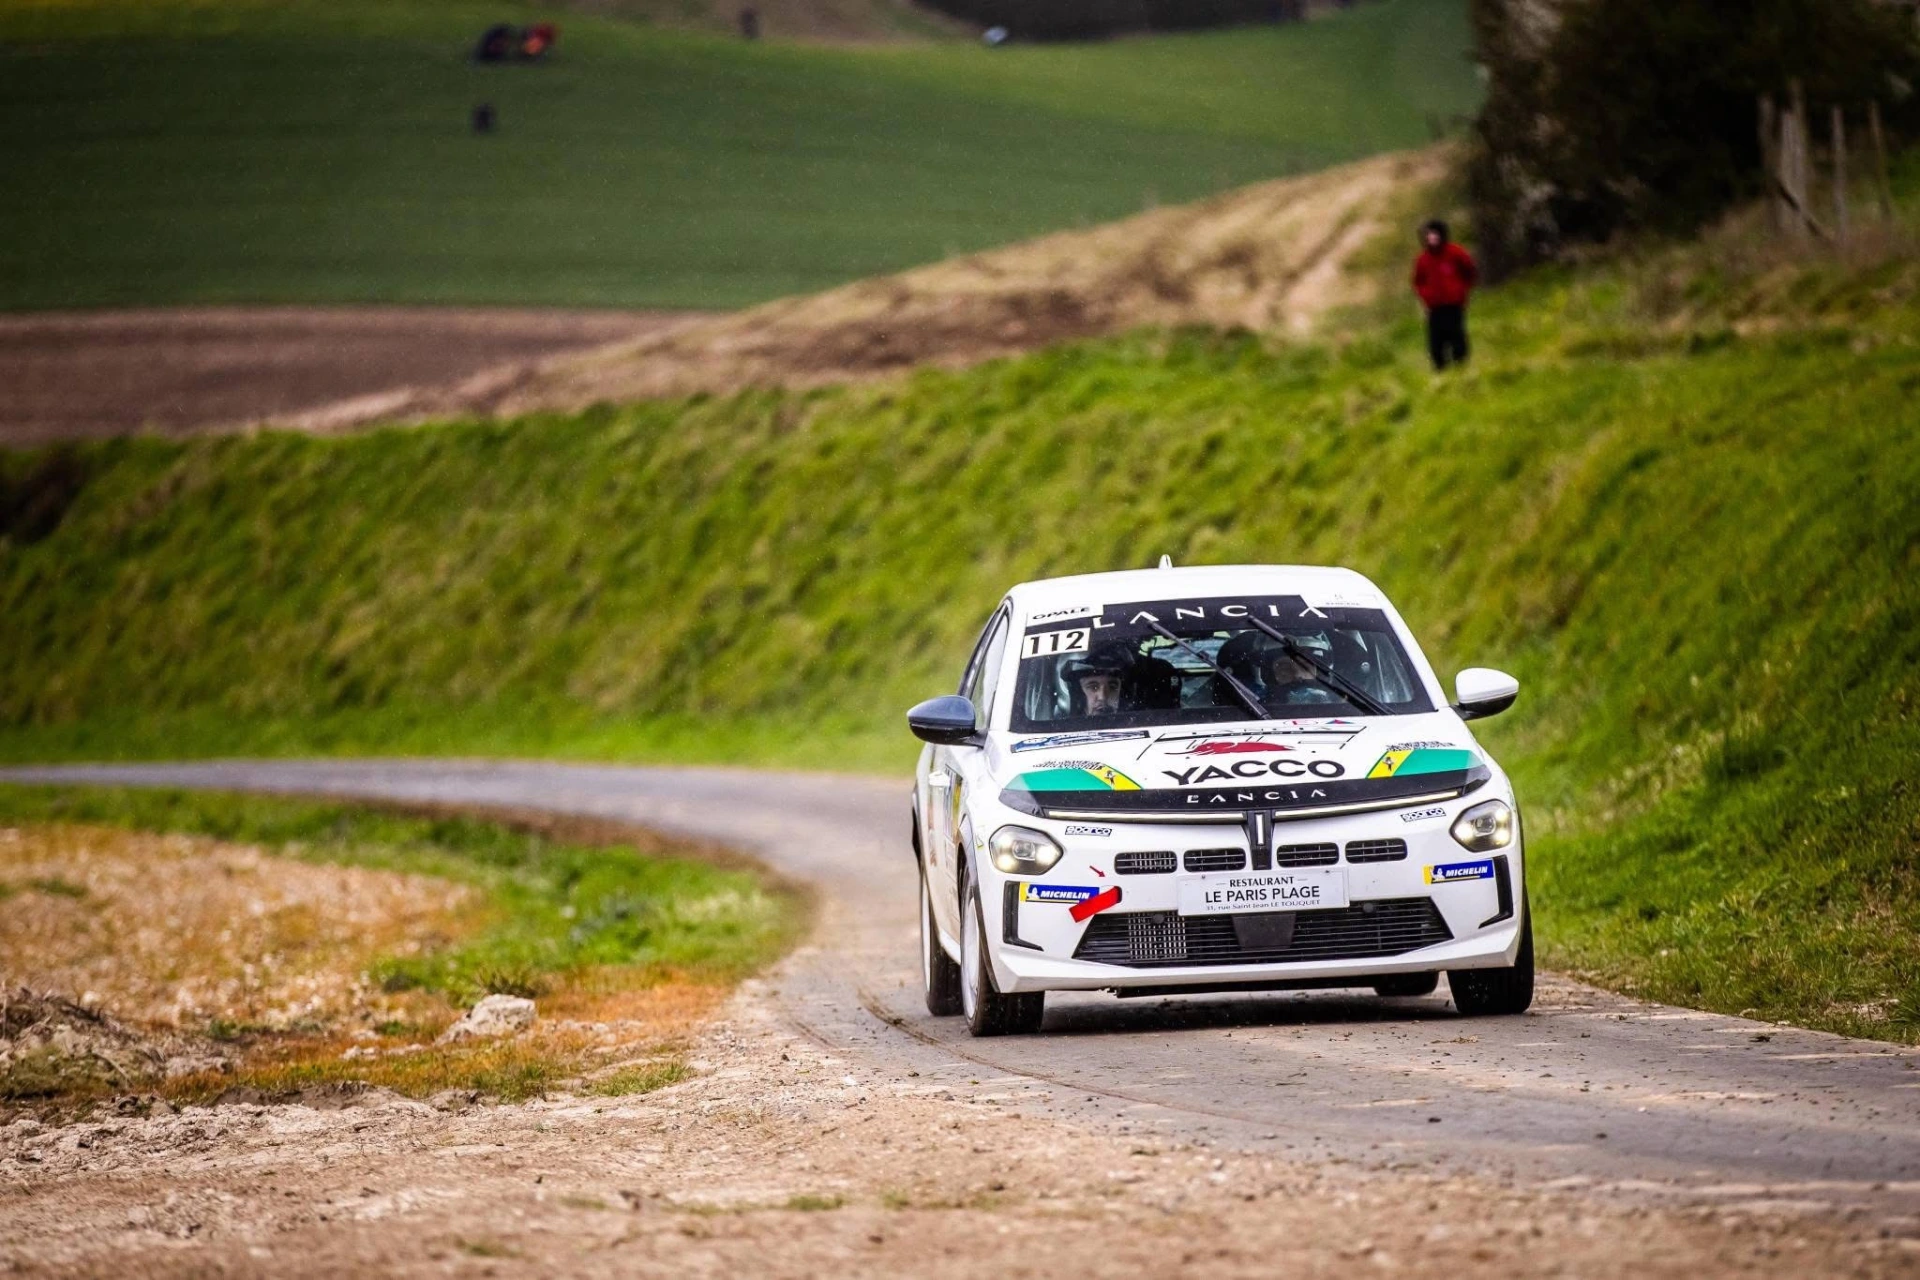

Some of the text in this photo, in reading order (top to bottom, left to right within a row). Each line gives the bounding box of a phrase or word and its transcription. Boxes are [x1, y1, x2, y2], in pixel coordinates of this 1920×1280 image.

[1032, 606, 1090, 620] OPALE
[1093, 605, 1328, 629] LANCIA
[1030, 630, 1085, 655] 112
[1161, 758, 1345, 786] YACCO
[1186, 788, 1327, 804] LANCIA
[1445, 866, 1488, 877] MICHELIN
[1230, 876, 1294, 888] RESTAURANT
[1040, 890, 1090, 900] MICHELIN
[1205, 885, 1320, 903] LE PARIS PLAGE
[1281, 899, 1320, 907] TOUQUET
